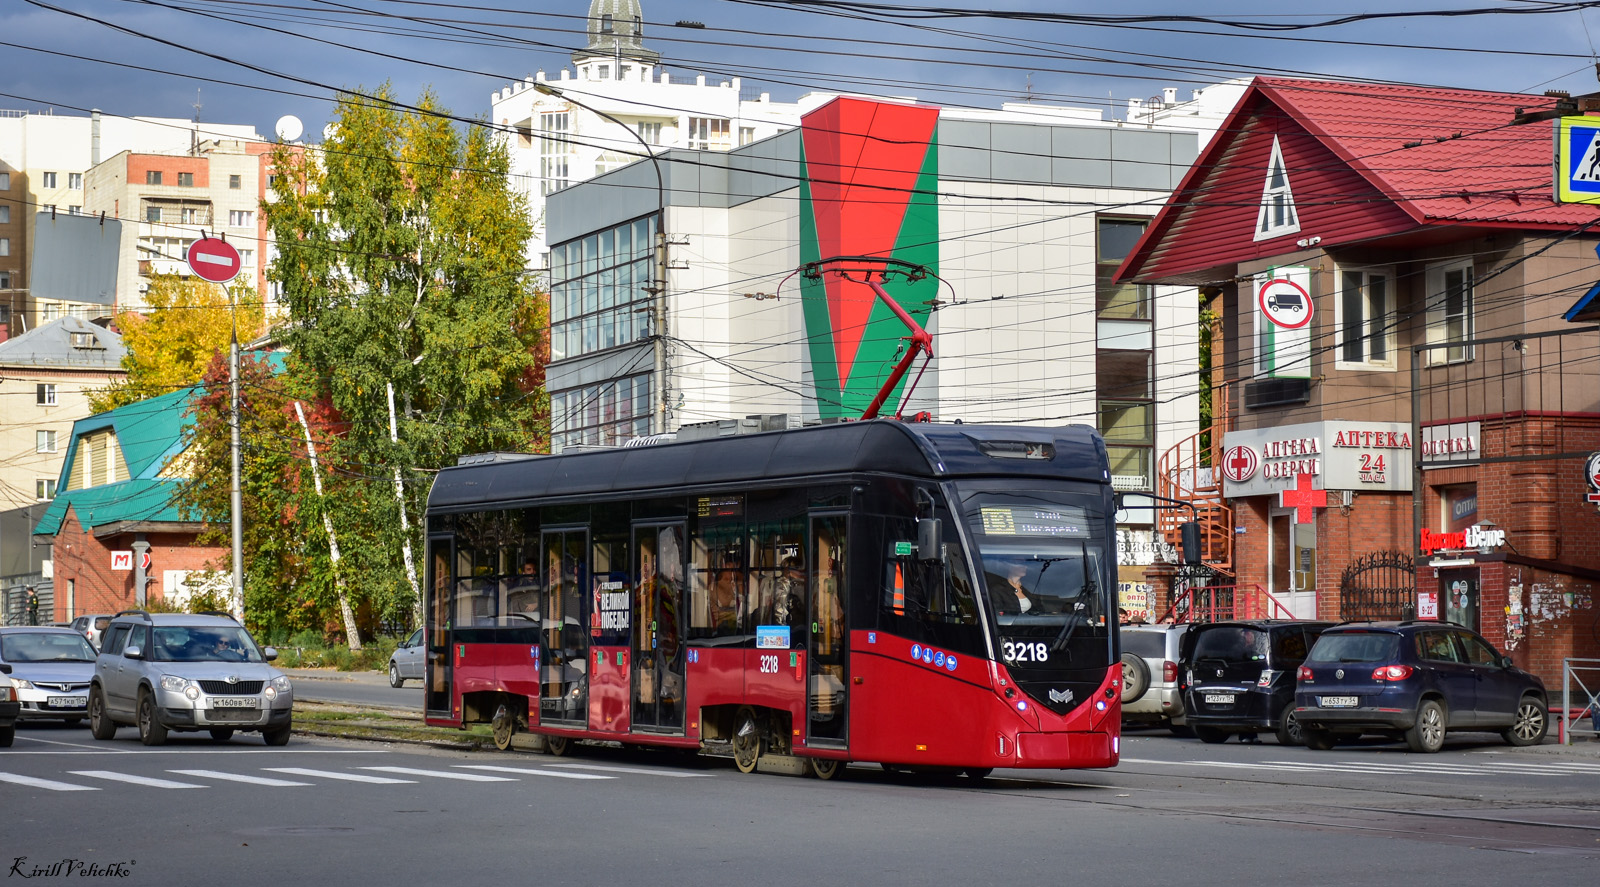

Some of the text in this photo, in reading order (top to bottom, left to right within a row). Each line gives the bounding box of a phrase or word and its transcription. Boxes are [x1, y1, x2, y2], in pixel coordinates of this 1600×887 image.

[1262, 438, 1320, 458] АПТЕКА
[1334, 430, 1412, 448] АПТЕКА
[1422, 437, 1475, 456] ОПТИКА
[1263, 459, 1317, 479] ОЗЕРКИ
[1359, 453, 1386, 472] 24
[1360, 474, 1386, 483] ЧАСА
[1455, 497, 1477, 515] ОПТИ
[602, 590, 629, 610] ВЕЛИКОЙ
[602, 611, 629, 631] ПОБЕДЫ!
[1004, 642, 1048, 662] 3218
[760, 655, 778, 673] 3218
